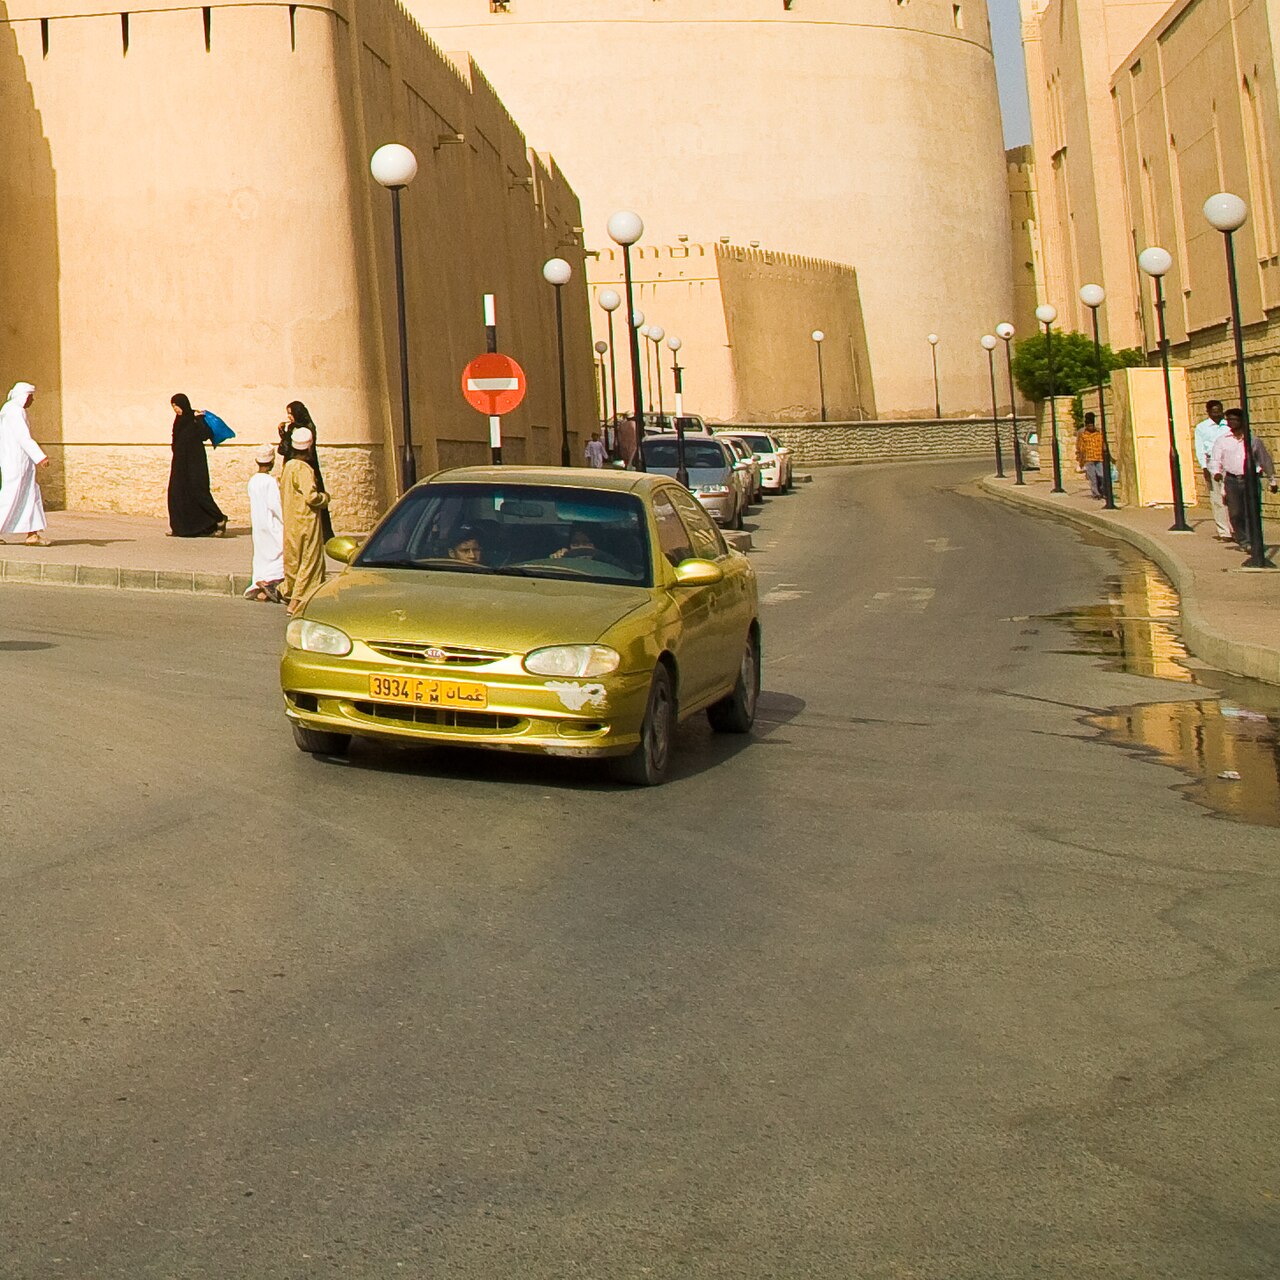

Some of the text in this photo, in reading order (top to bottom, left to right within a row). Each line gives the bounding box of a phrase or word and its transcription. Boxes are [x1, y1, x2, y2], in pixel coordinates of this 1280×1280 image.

[426, 649, 444, 657] KIA
[374, 677, 409, 698] 3934
[415, 692, 439, 703] R M
